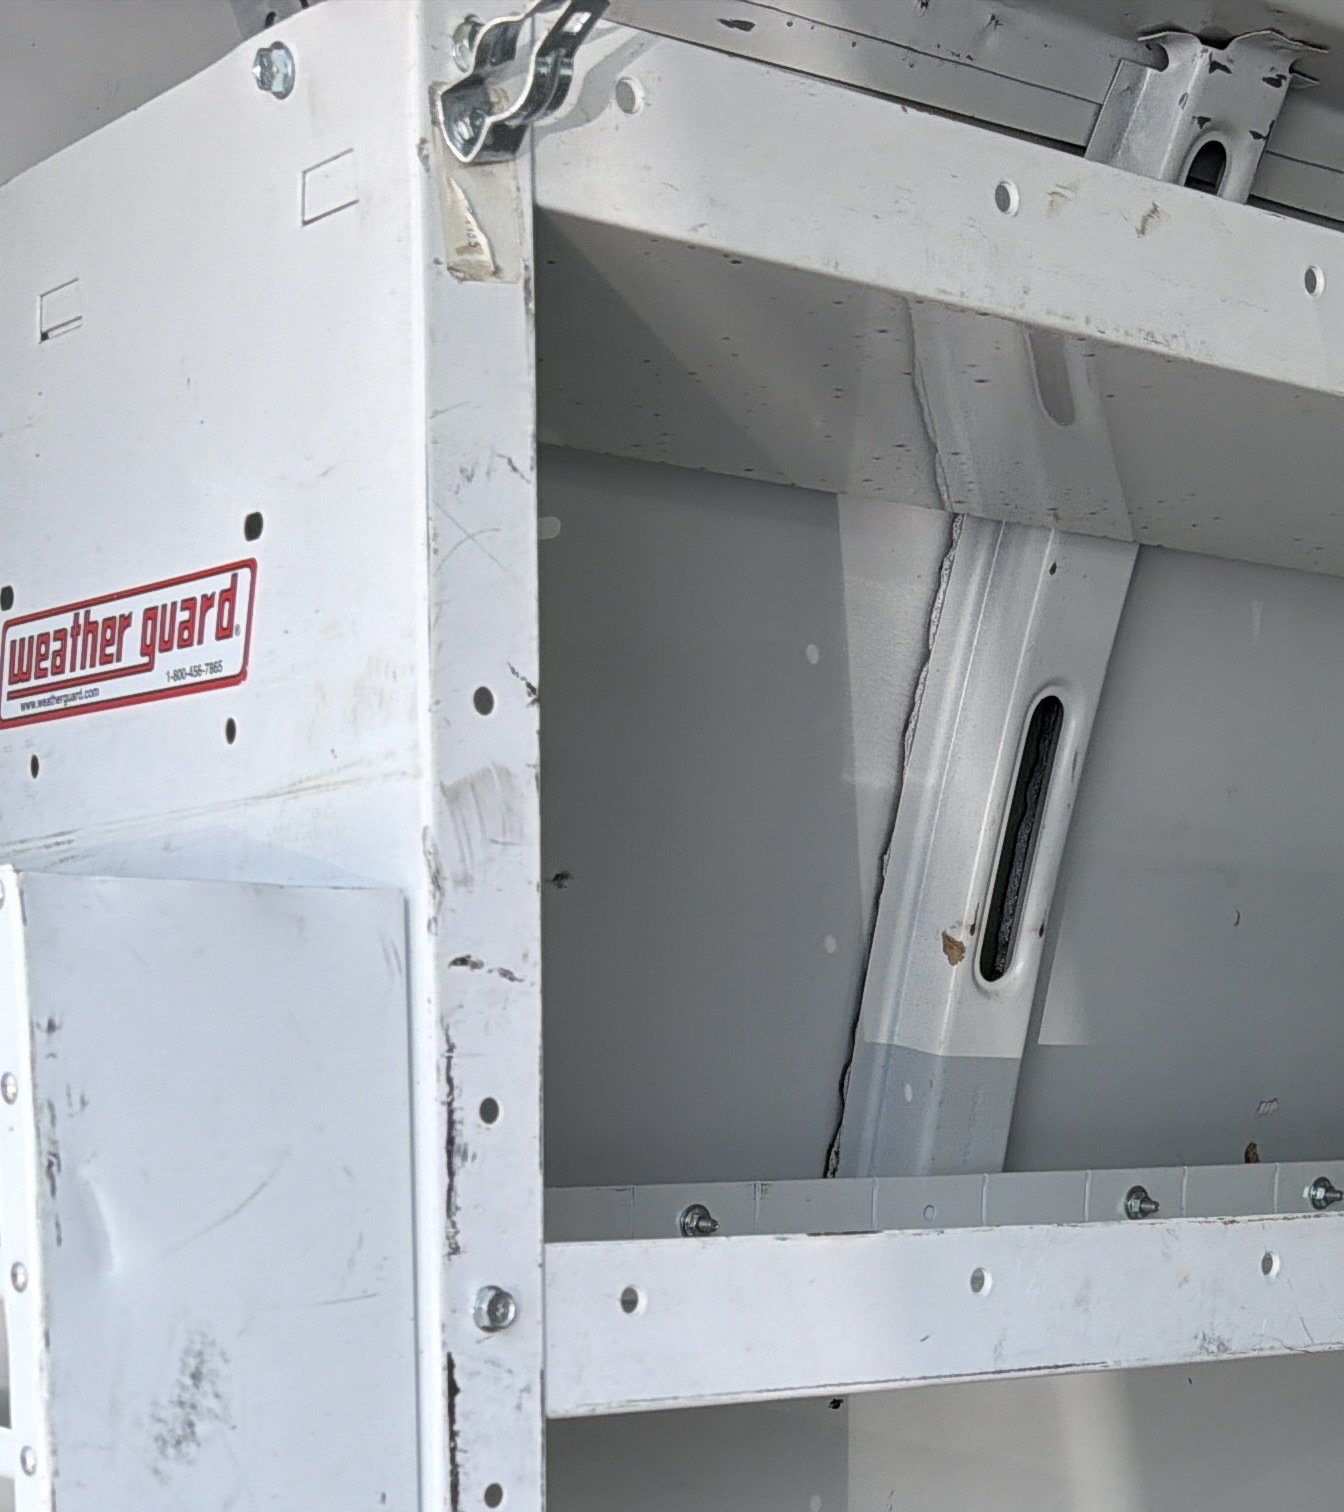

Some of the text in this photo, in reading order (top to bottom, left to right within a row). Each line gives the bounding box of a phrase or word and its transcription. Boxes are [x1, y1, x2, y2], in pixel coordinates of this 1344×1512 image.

[7, 609, 132, 685] weather
[167, 659, 224, 682] 1-800-456-7865
[19, 686, 100, 711] www.weatherguard.com
